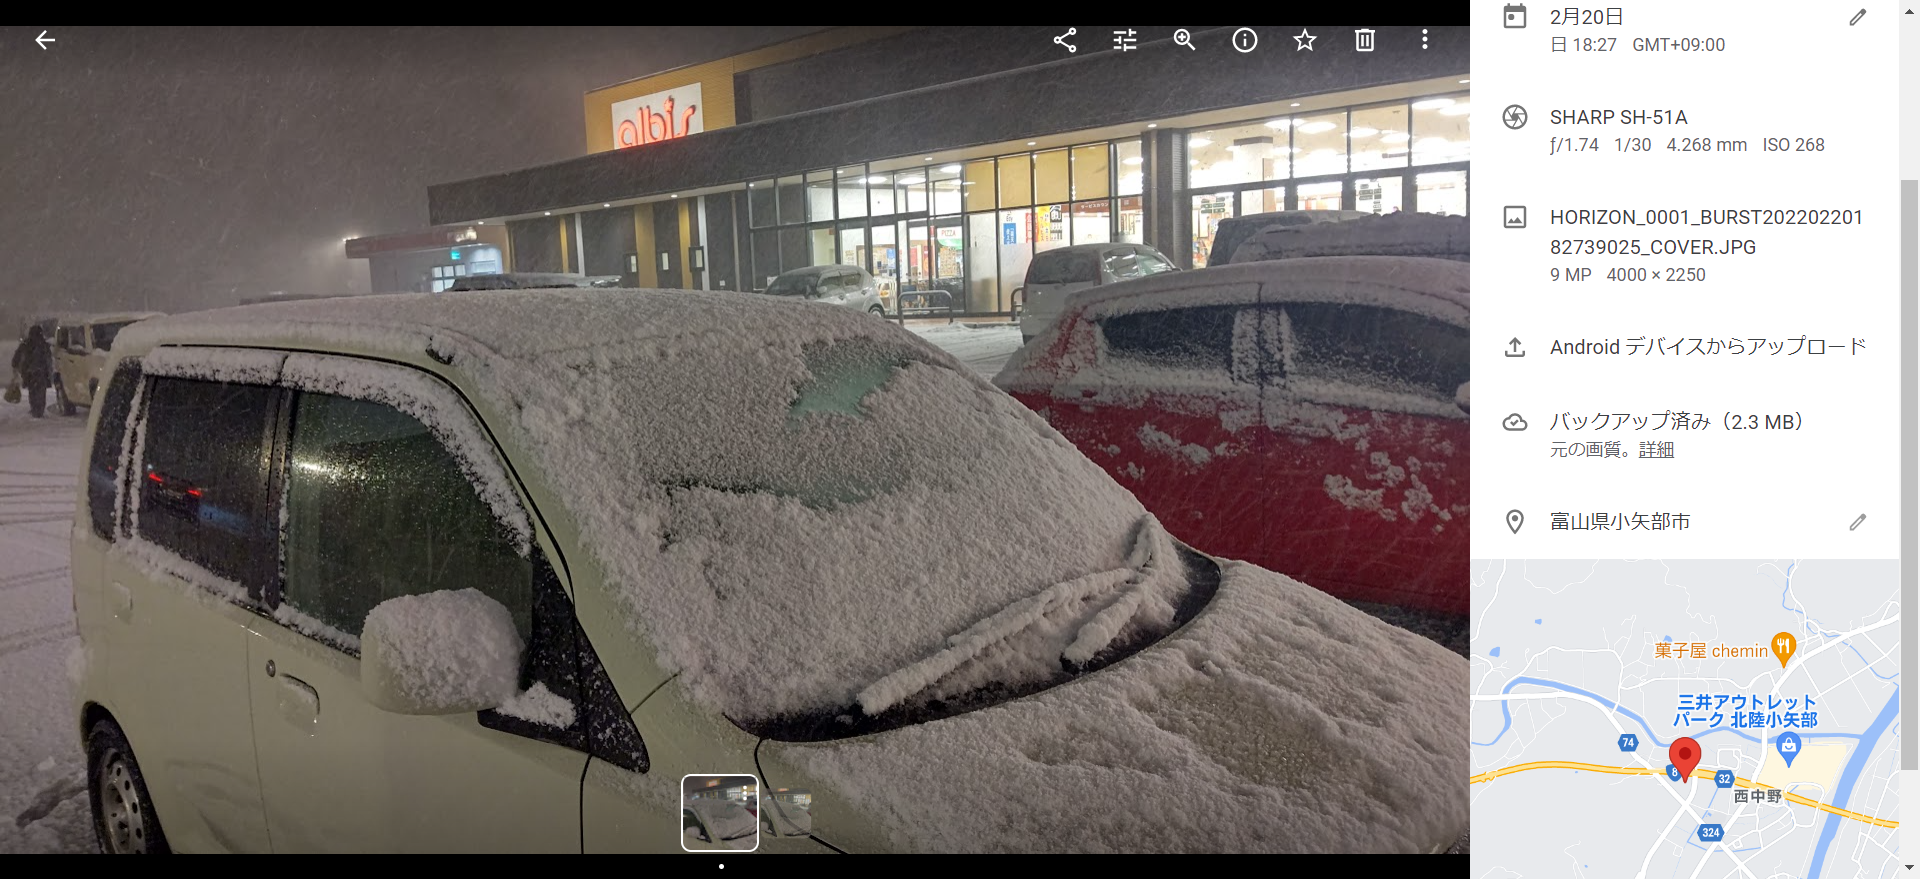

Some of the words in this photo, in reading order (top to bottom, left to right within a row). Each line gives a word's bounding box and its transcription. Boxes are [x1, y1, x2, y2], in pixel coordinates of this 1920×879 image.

[1551, 8, 1623, 26] 2月20日
[1551, 37, 1567, 53] 日
[1573, 37, 1618, 52] 18:27
[1632, 37, 1726, 52] GMT+09:00
[618, 95, 696, 149] albis
[1550, 109, 1615, 125] SHARP
[1620, 109, 1689, 125] SH-51A
[1614, 137, 1652, 153] 1/30
[1666, 137, 1712, 152] 4.268
[1716, 140, 1748, 152] mm
[1763, 137, 1791, 152] ISO
[1795, 137, 1825, 152] 268
[1551, 209, 1862, 227] HORIZON_0001_BURST202202201
[1550, 239, 1756, 257] 82739025_COVER.JPG
[1550, 267, 1560, 282] 9
[1565, 267, 1592, 282] MP
[1606, 267, 1647, 282] 4000
[1665, 267, 1706, 282] 2250
[1550, 337, 1620, 355] Android
[1625, 335, 1866, 356] デバイスからアップロード
[1550, 511, 1691, 531] 富山県小矢部市
[1655, 642, 1707, 659] 菓子屋
[1712, 643, 1768, 658] chemin
[1677, 693, 1816, 711] 三井アウトレット
[1673, 711, 1724, 728] パーク
[1730, 711, 1818, 729] 北陸小矢部
[1622, 737, 1635, 748] 74
[1671, 767, 1678, 777] 8
[1718, 774, 1731, 784] 32
[1734, 789, 1782, 804] 西中野
[1702, 828, 1720, 838] 324
